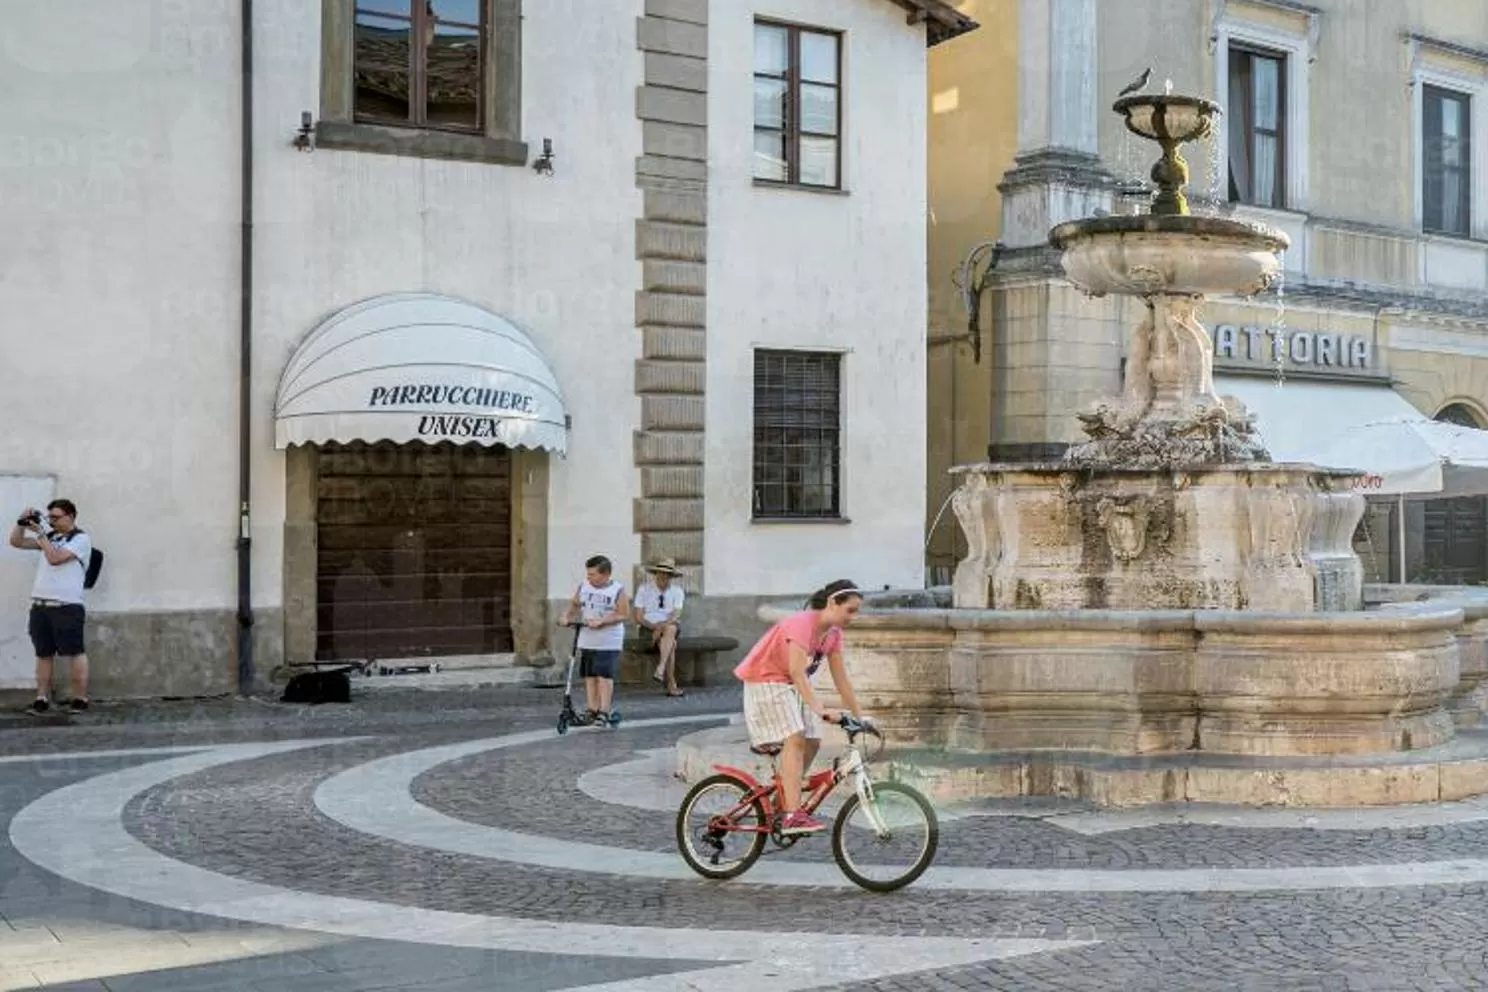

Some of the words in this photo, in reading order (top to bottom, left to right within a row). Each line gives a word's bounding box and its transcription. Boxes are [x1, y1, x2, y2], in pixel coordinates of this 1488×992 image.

[1214, 324, 1373, 369] ATTORIA
[369, 384, 534, 413] PARRUCCHIERE
[417, 416, 502, 438] UNISEX
